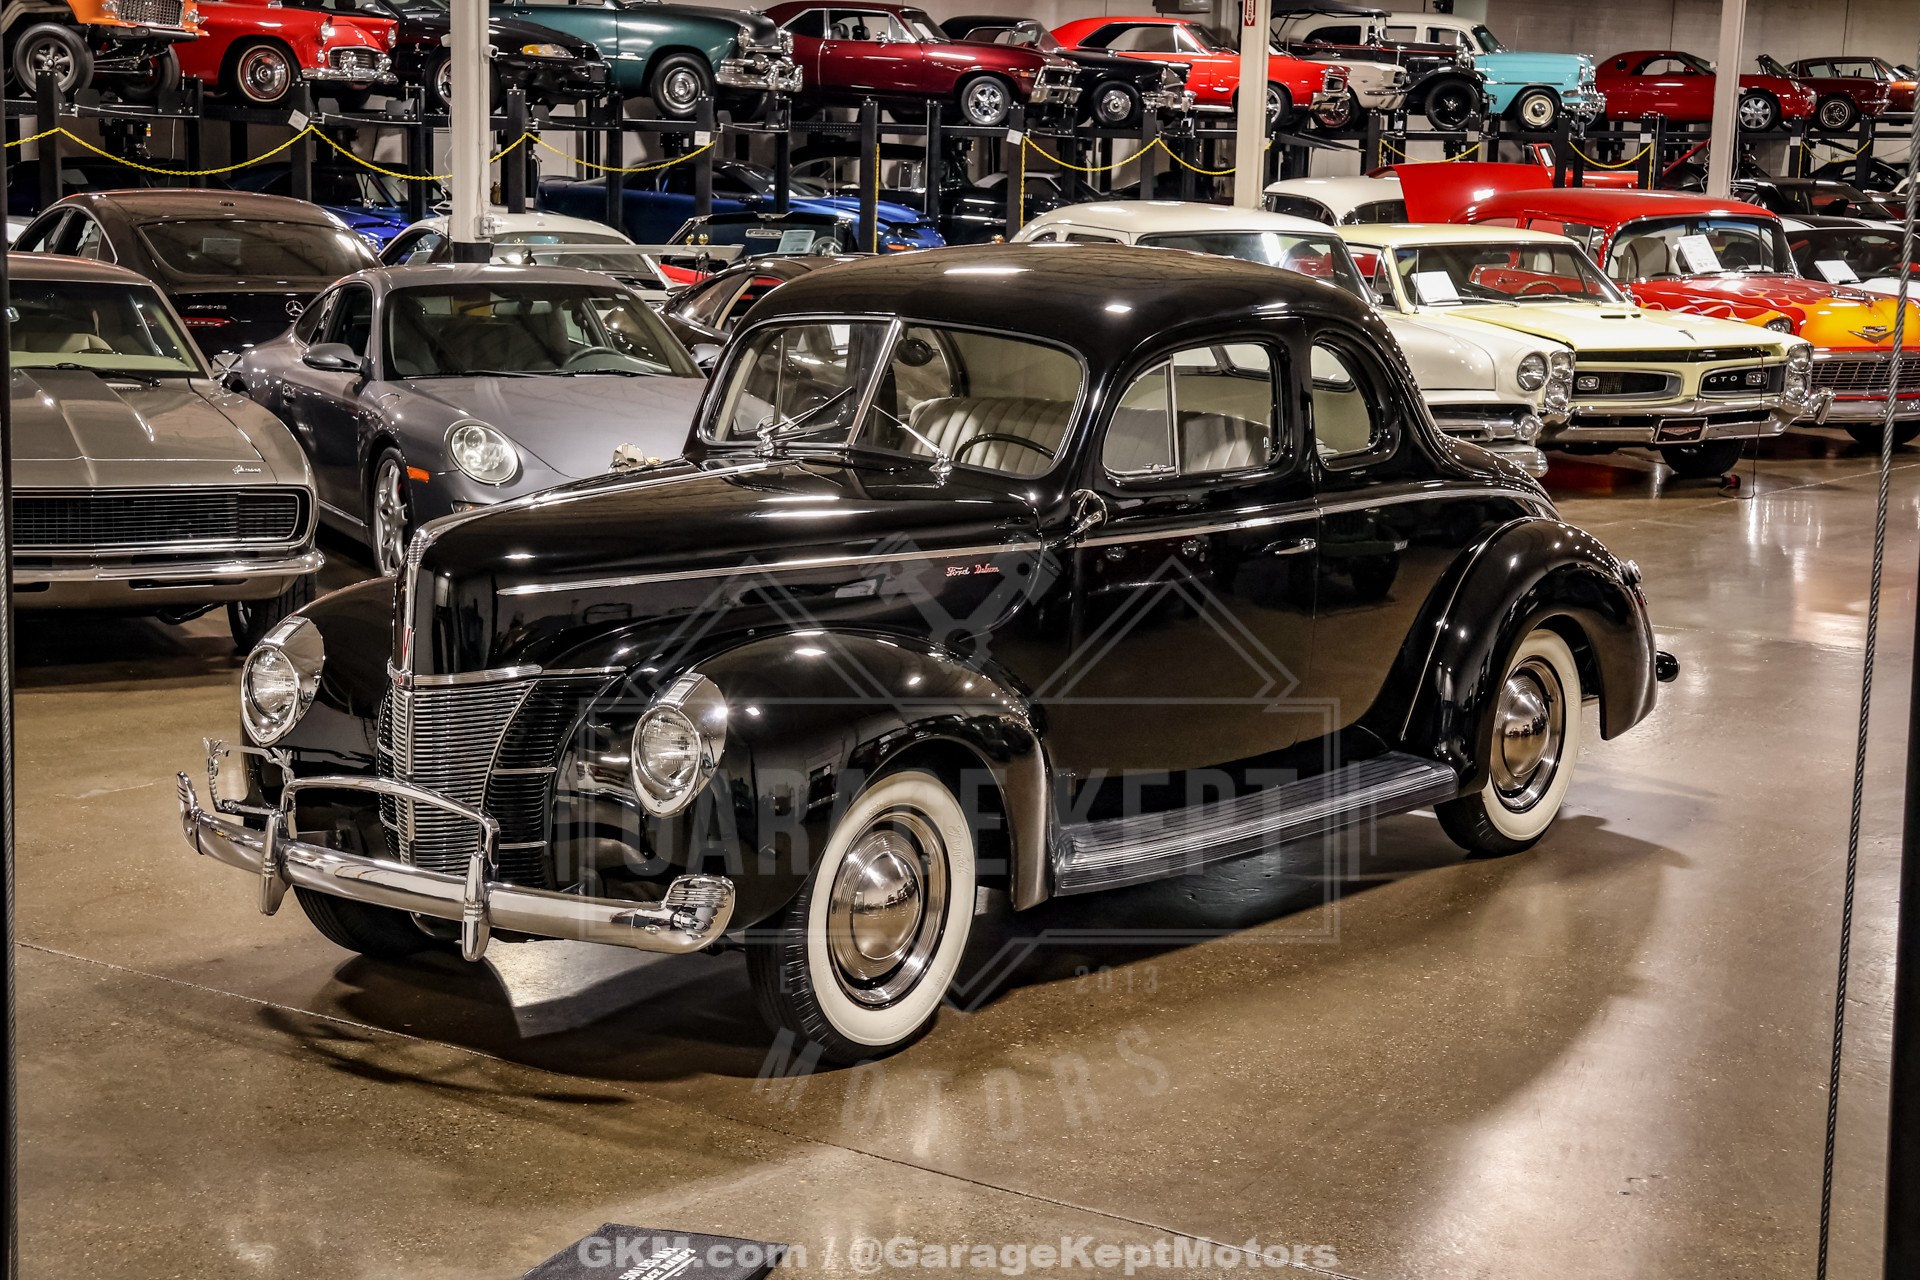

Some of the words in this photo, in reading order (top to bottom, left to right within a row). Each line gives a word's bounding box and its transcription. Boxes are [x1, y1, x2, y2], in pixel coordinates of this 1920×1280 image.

[1709, 375, 1738, 383] GTO
[945, 566, 970, 577] Ford
[659, 1248, 696, 1270] RAMPS
